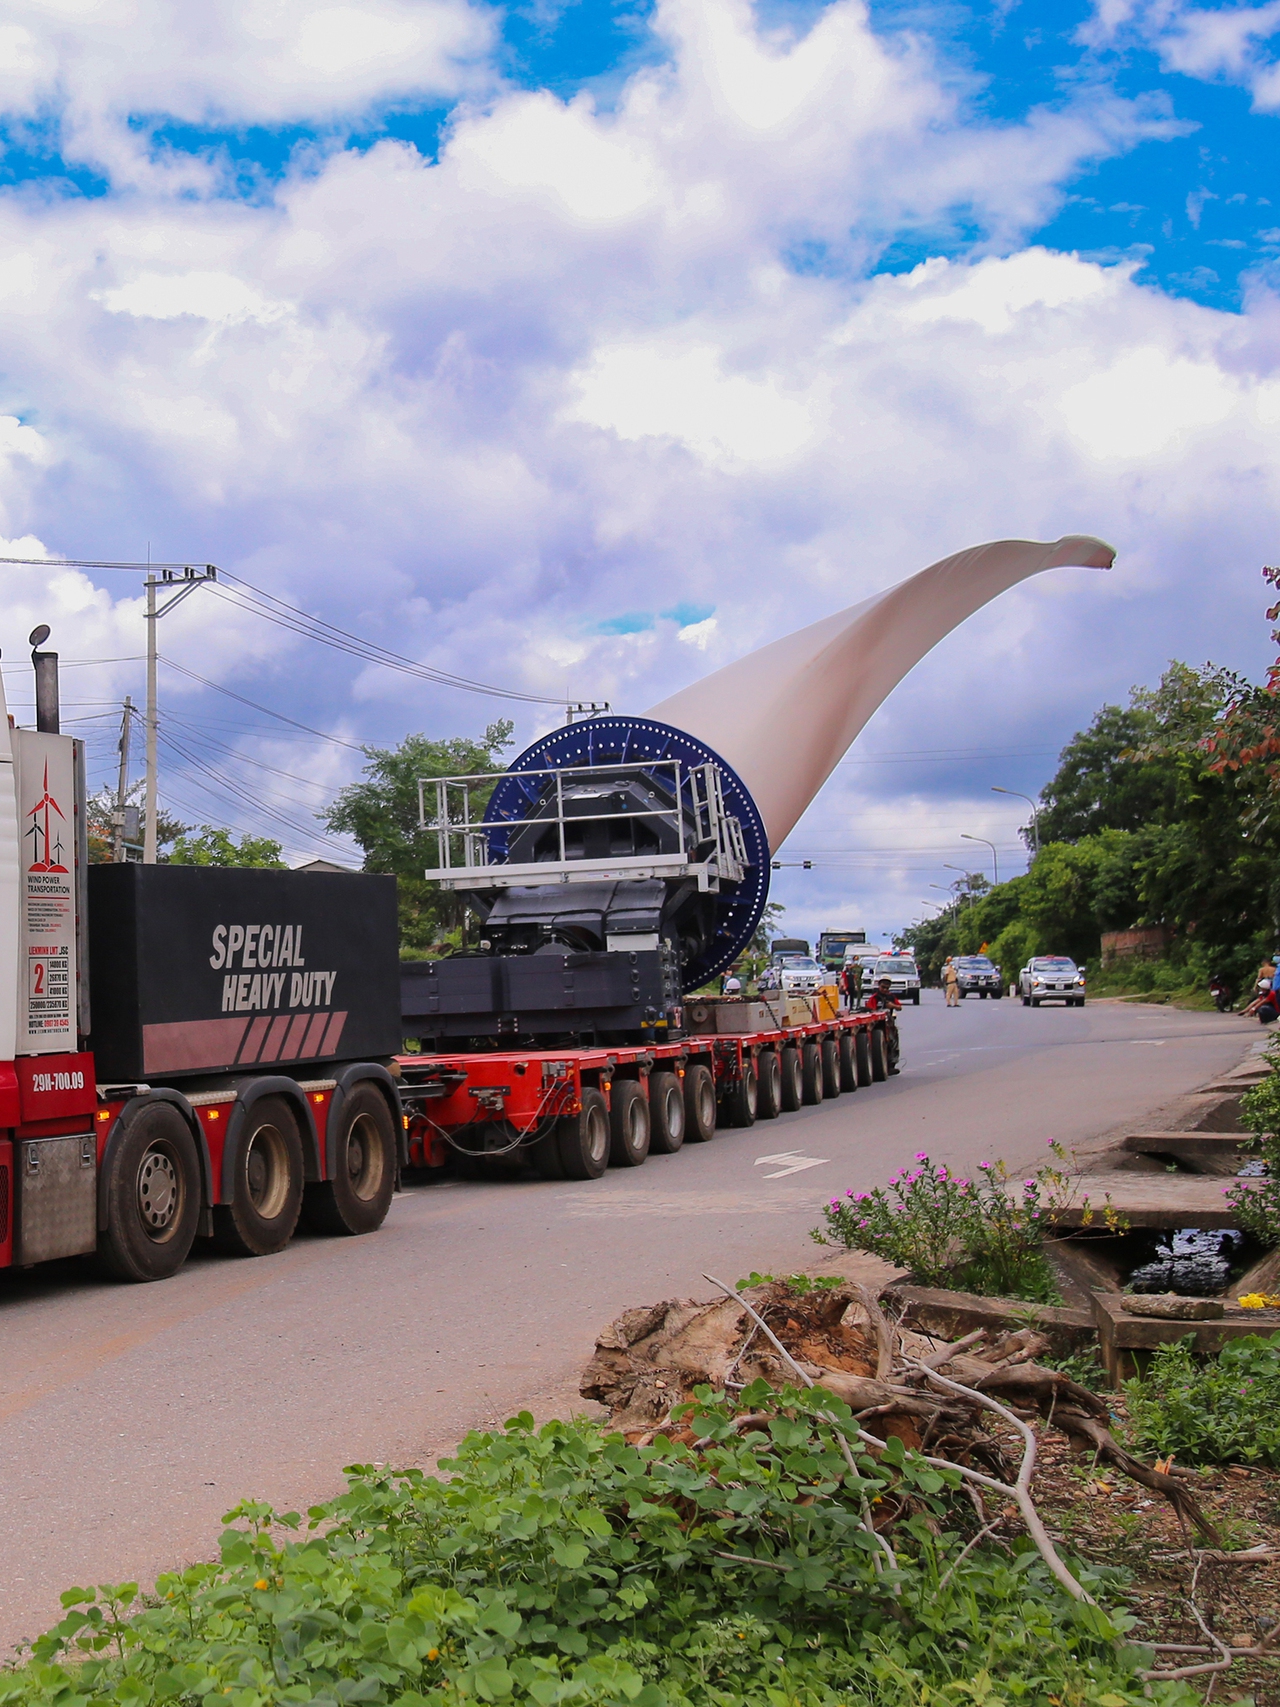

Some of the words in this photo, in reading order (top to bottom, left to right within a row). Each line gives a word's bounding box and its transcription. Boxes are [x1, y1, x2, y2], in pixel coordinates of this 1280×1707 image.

[28, 876, 41, 884] WIND
[43, 876, 60, 885] POWER
[28, 885, 70, 894] TRANSPORTATION
[209, 924, 305, 970] SPECIAL
[34, 963, 44, 994] 2
[221, 972, 287, 1012] HEAVY
[289, 971, 337, 1008] DUTY
[32, 1071, 84, 1092] 29H-700.09
